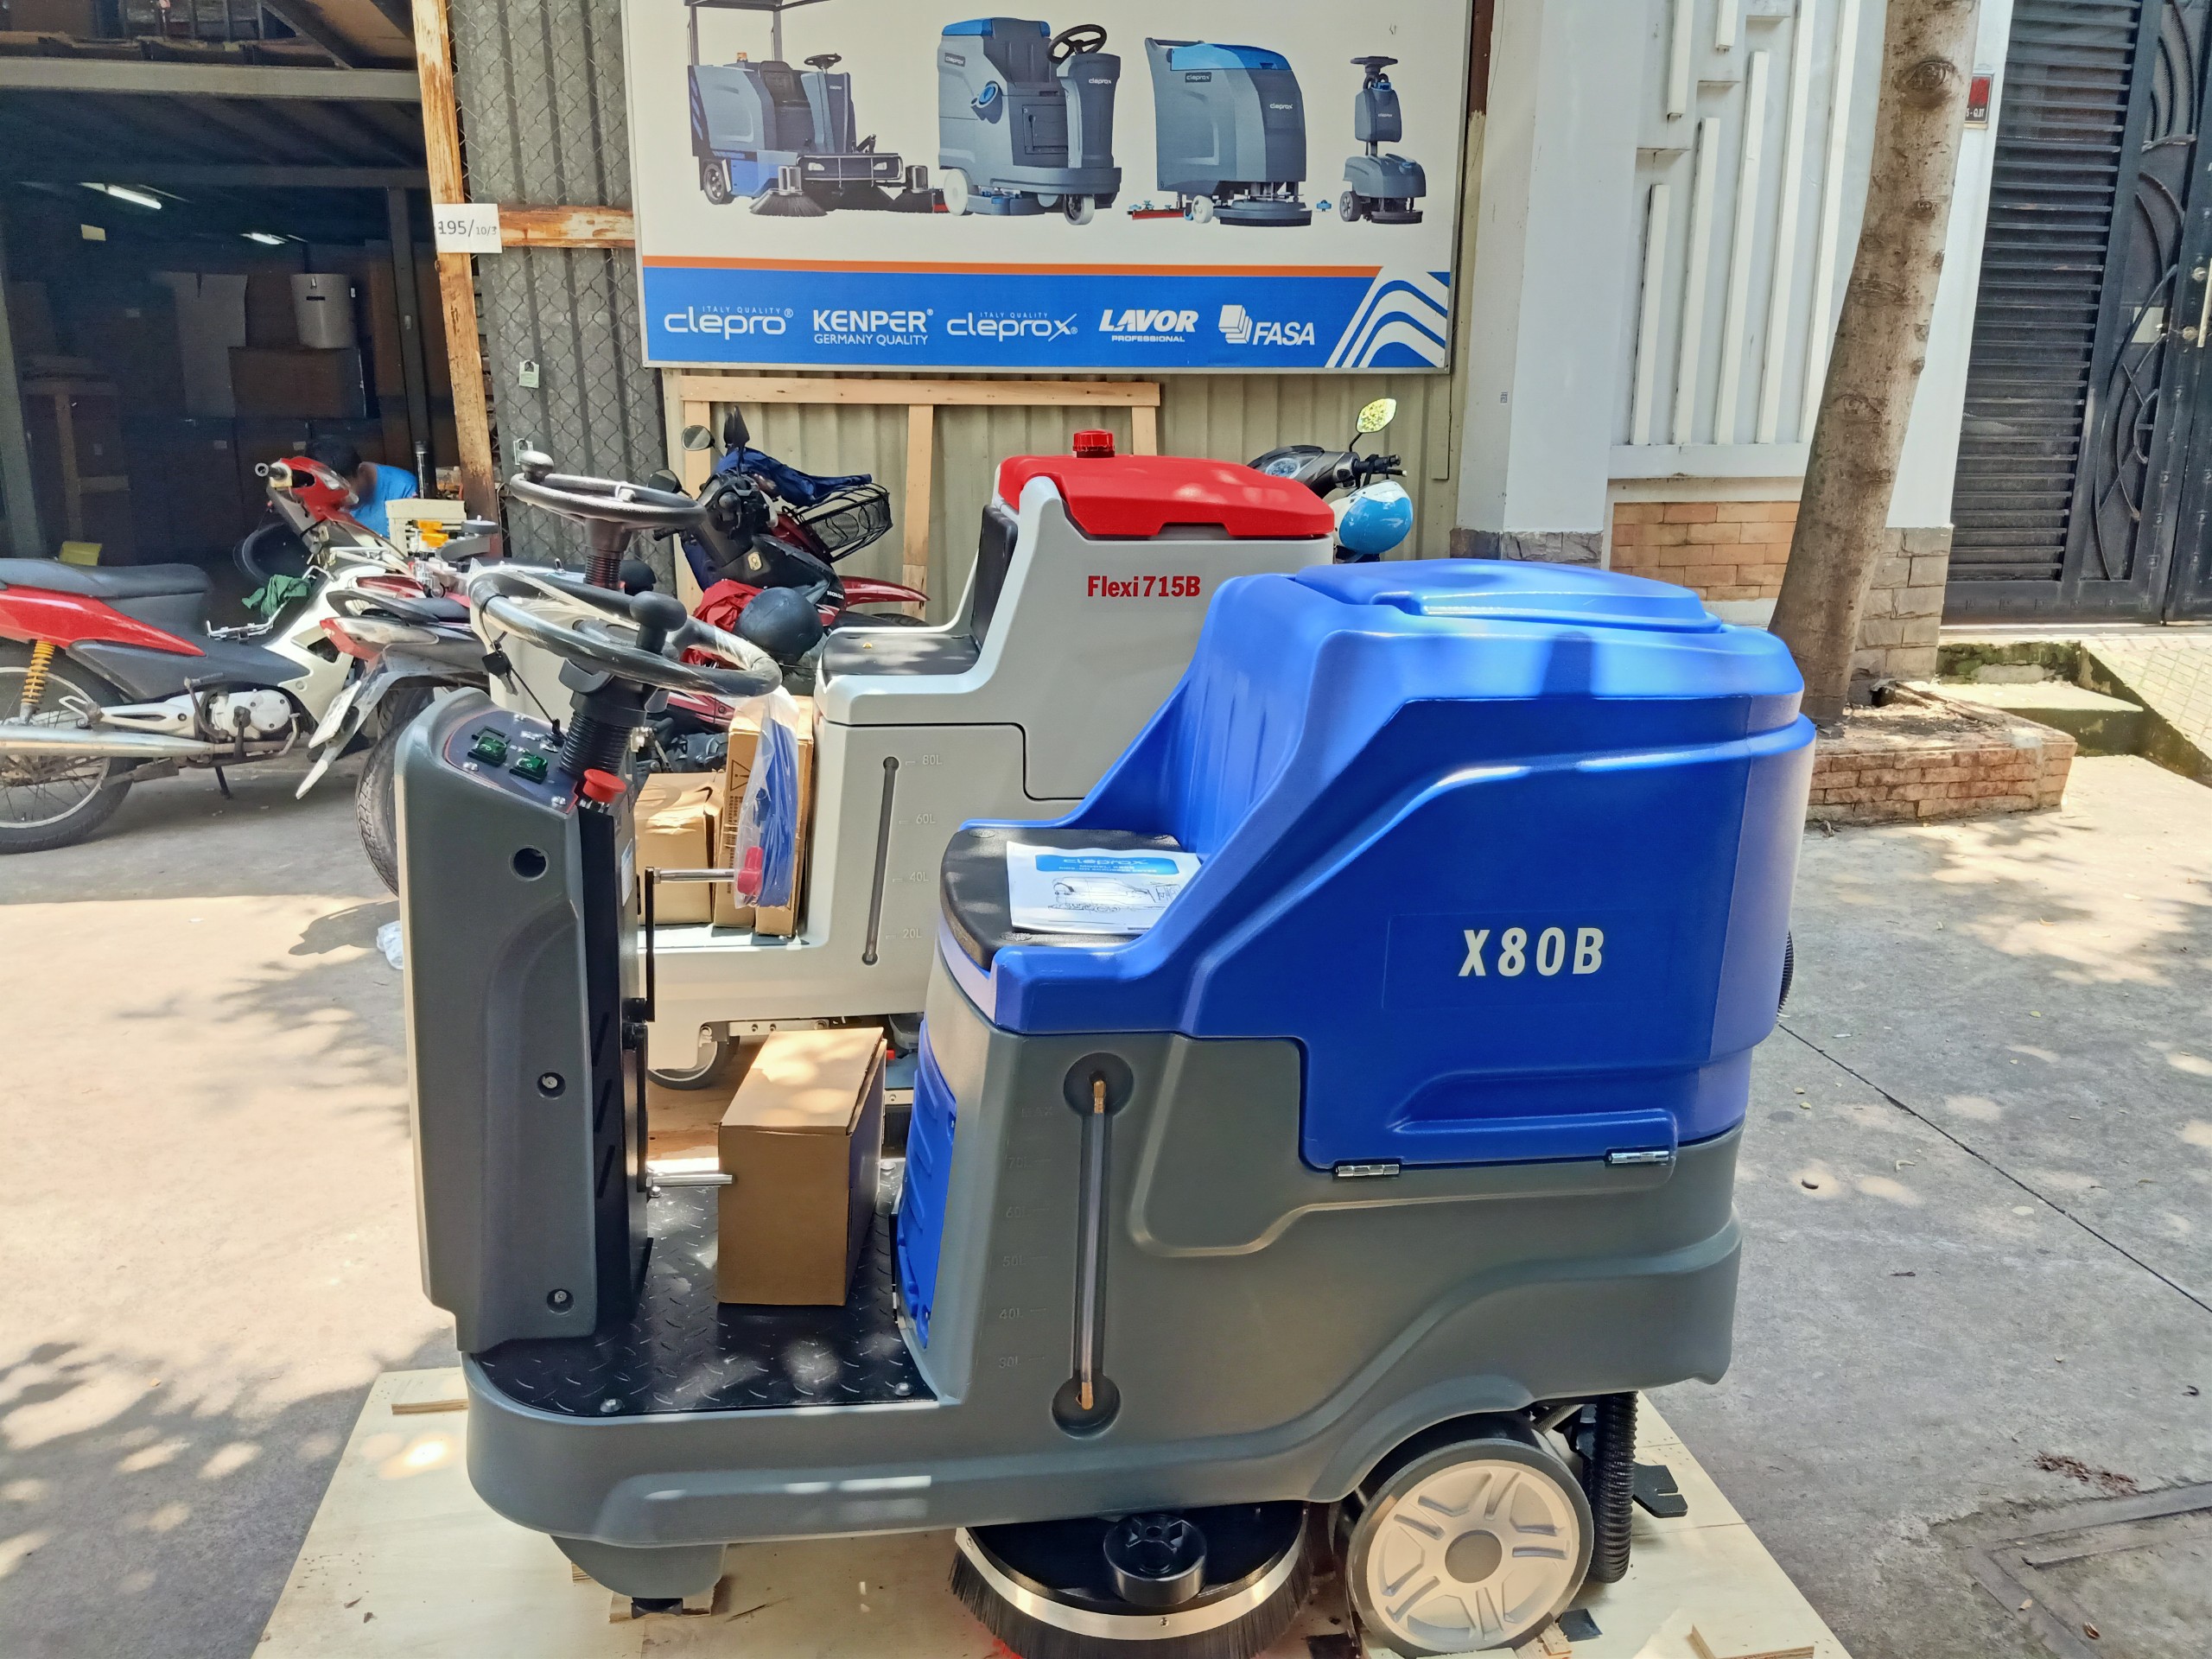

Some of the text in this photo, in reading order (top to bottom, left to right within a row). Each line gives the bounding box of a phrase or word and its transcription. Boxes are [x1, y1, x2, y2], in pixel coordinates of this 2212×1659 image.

[736, 306, 781, 315] QUALITY
[664, 306, 786, 340] clepro
[813, 309, 927, 334] KENPER
[1098, 309, 1199, 333] LAVOR
[1111, 334, 1185, 343] PROFESSIONAL
[1252, 321, 1315, 346] FASA
[814, 334, 929, 346] GERMANY QUALITY
[922, 754, 943, 766] 80L
[916, 813, 937, 824] 60L
[910, 871, 930, 882] 40L
[902, 928, 924, 939] 20L
[1458, 926, 1605, 977] X80B
